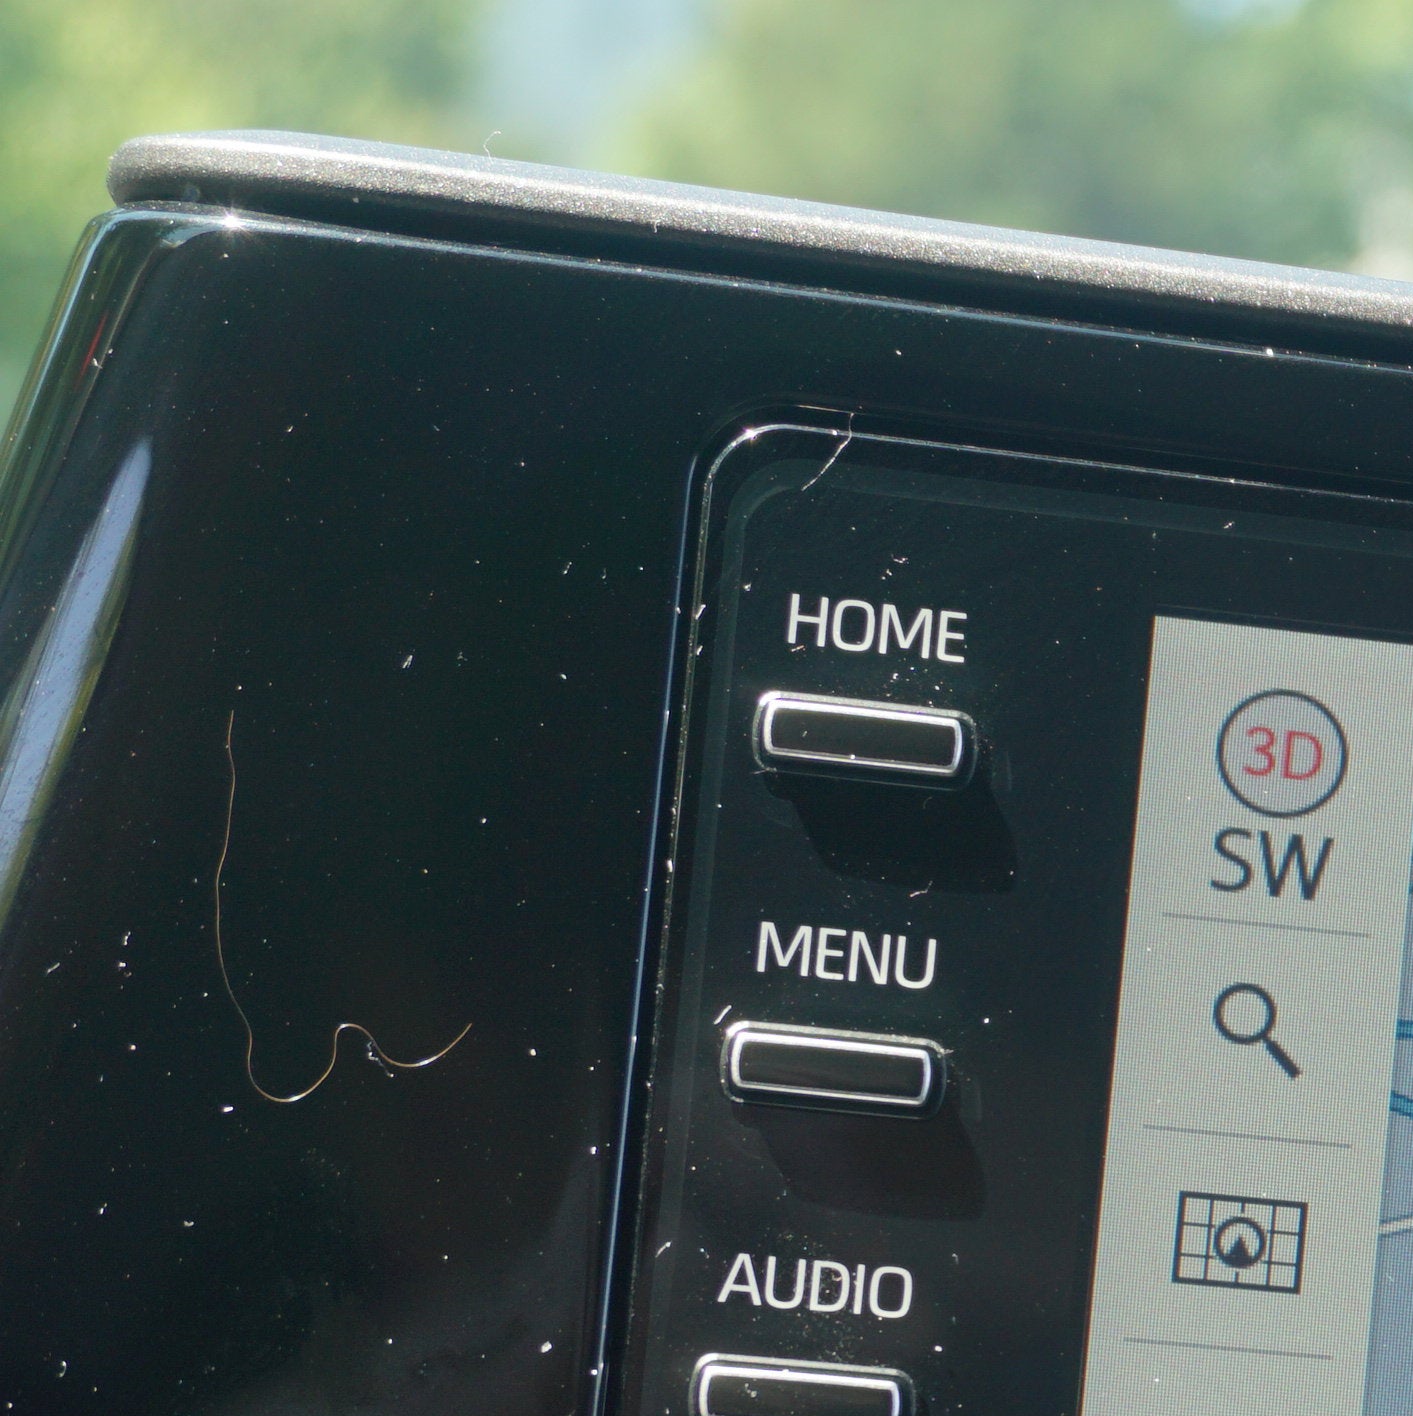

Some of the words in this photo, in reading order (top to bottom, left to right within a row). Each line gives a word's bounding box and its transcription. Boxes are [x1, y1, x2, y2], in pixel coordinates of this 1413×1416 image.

[787, 593, 968, 664] HOME
[1243, 726, 1323, 781] 3D
[1210, 827, 1335, 901] SW
[755, 921, 938, 990] MENU
[716, 1253, 914, 1320] AUDIO
